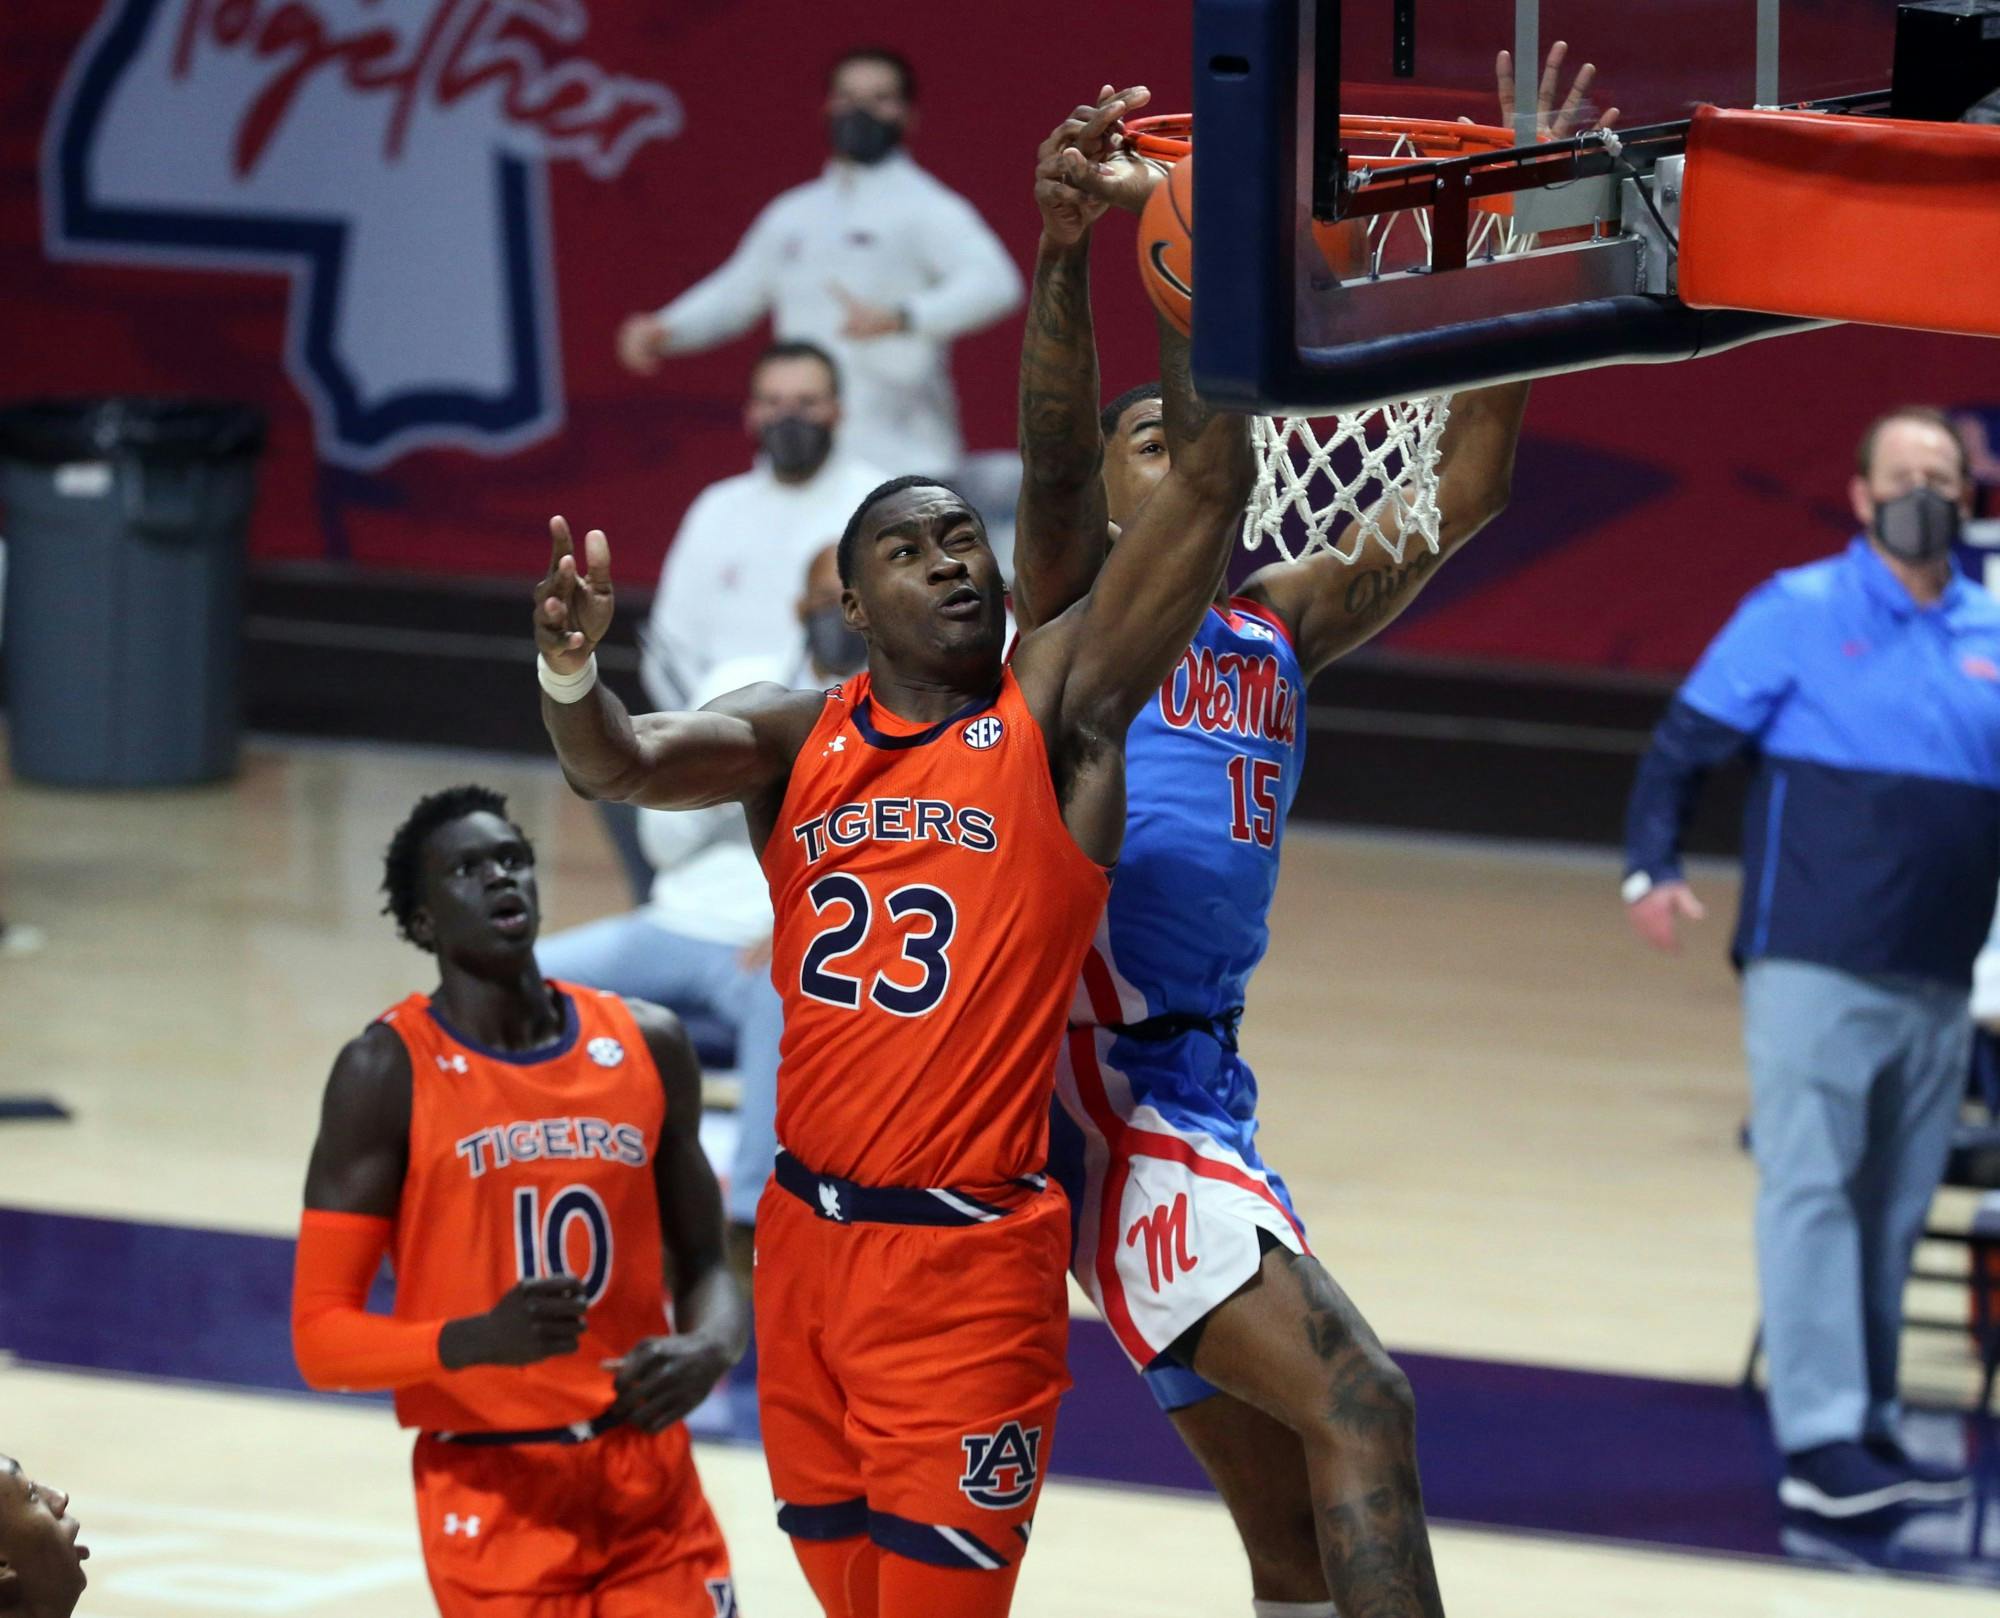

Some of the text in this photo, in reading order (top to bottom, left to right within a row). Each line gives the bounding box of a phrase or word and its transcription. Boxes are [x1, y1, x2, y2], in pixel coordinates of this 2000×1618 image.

[962, 716, 1004, 749] SEC
[1217, 652, 1298, 748] Mis
[1227, 754, 1282, 850] 15
[800, 871, 957, 1018] 23
[456, 1116, 648, 1178] TIGERS
[514, 1184, 613, 1308] 10
